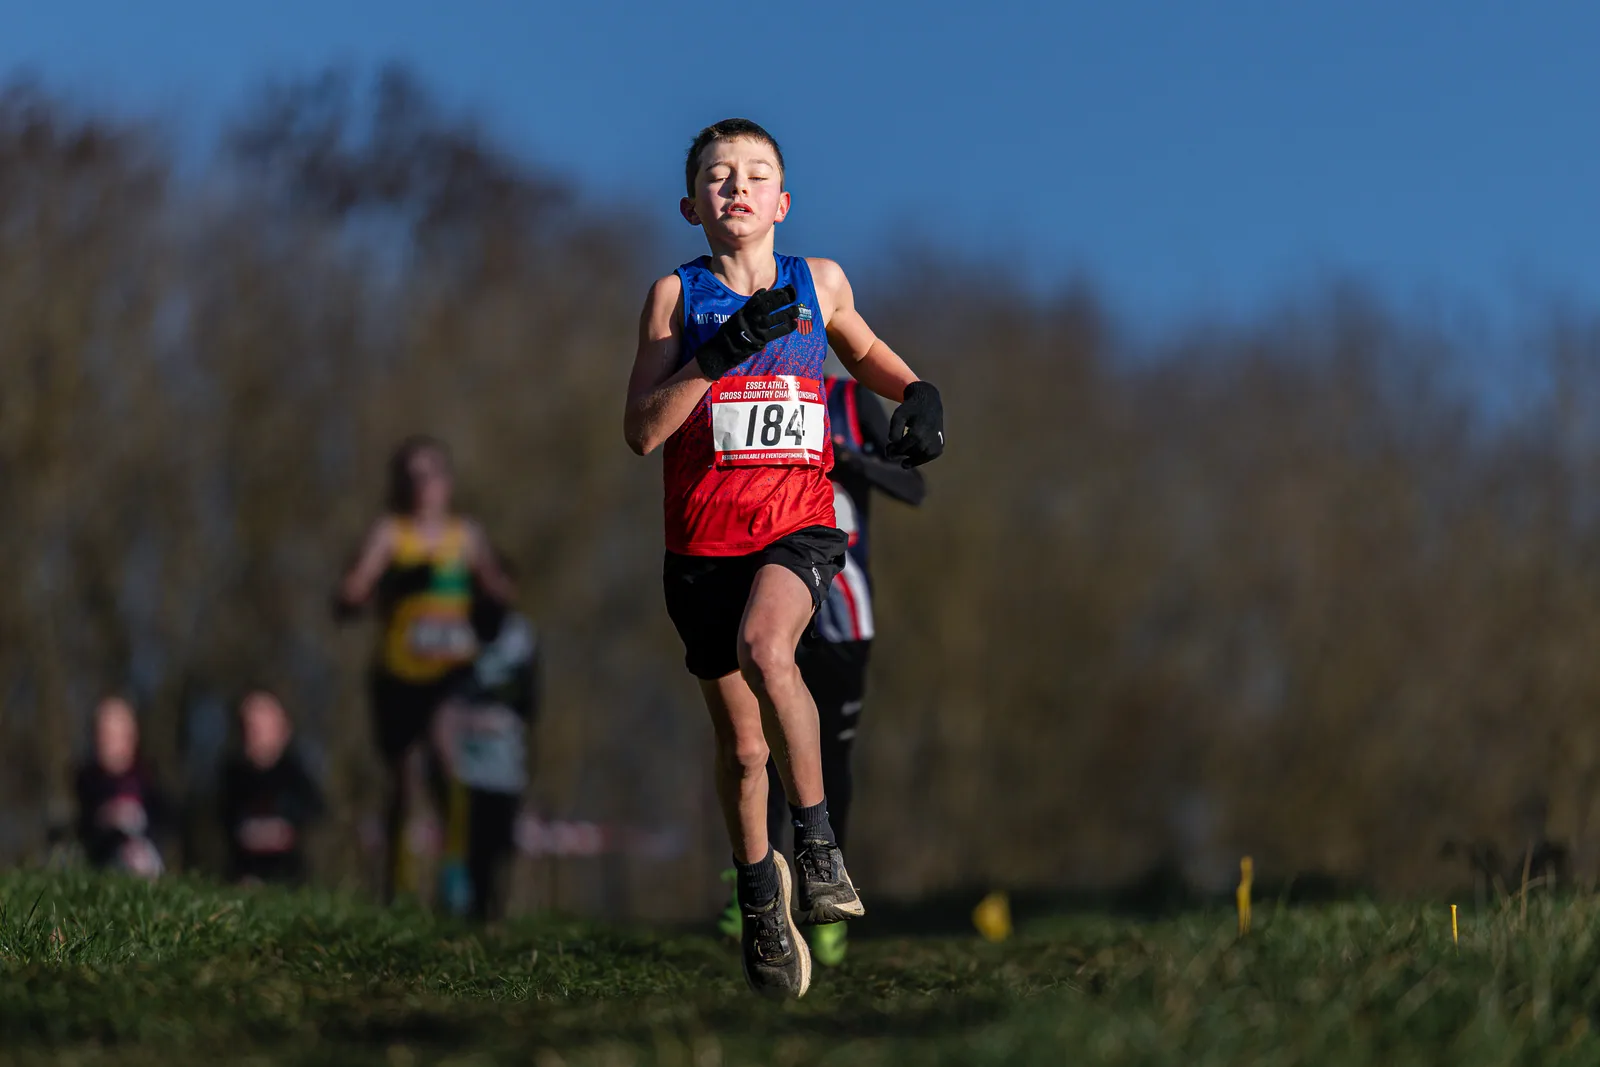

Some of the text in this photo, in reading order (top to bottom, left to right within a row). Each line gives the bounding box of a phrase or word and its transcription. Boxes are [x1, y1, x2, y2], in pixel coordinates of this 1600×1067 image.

[746, 381, 767, 390] ESSEX
[719, 391, 742, 401] CROSS
[743, 390, 773, 400] COUNTRY
[745, 404, 806, 447] 184
